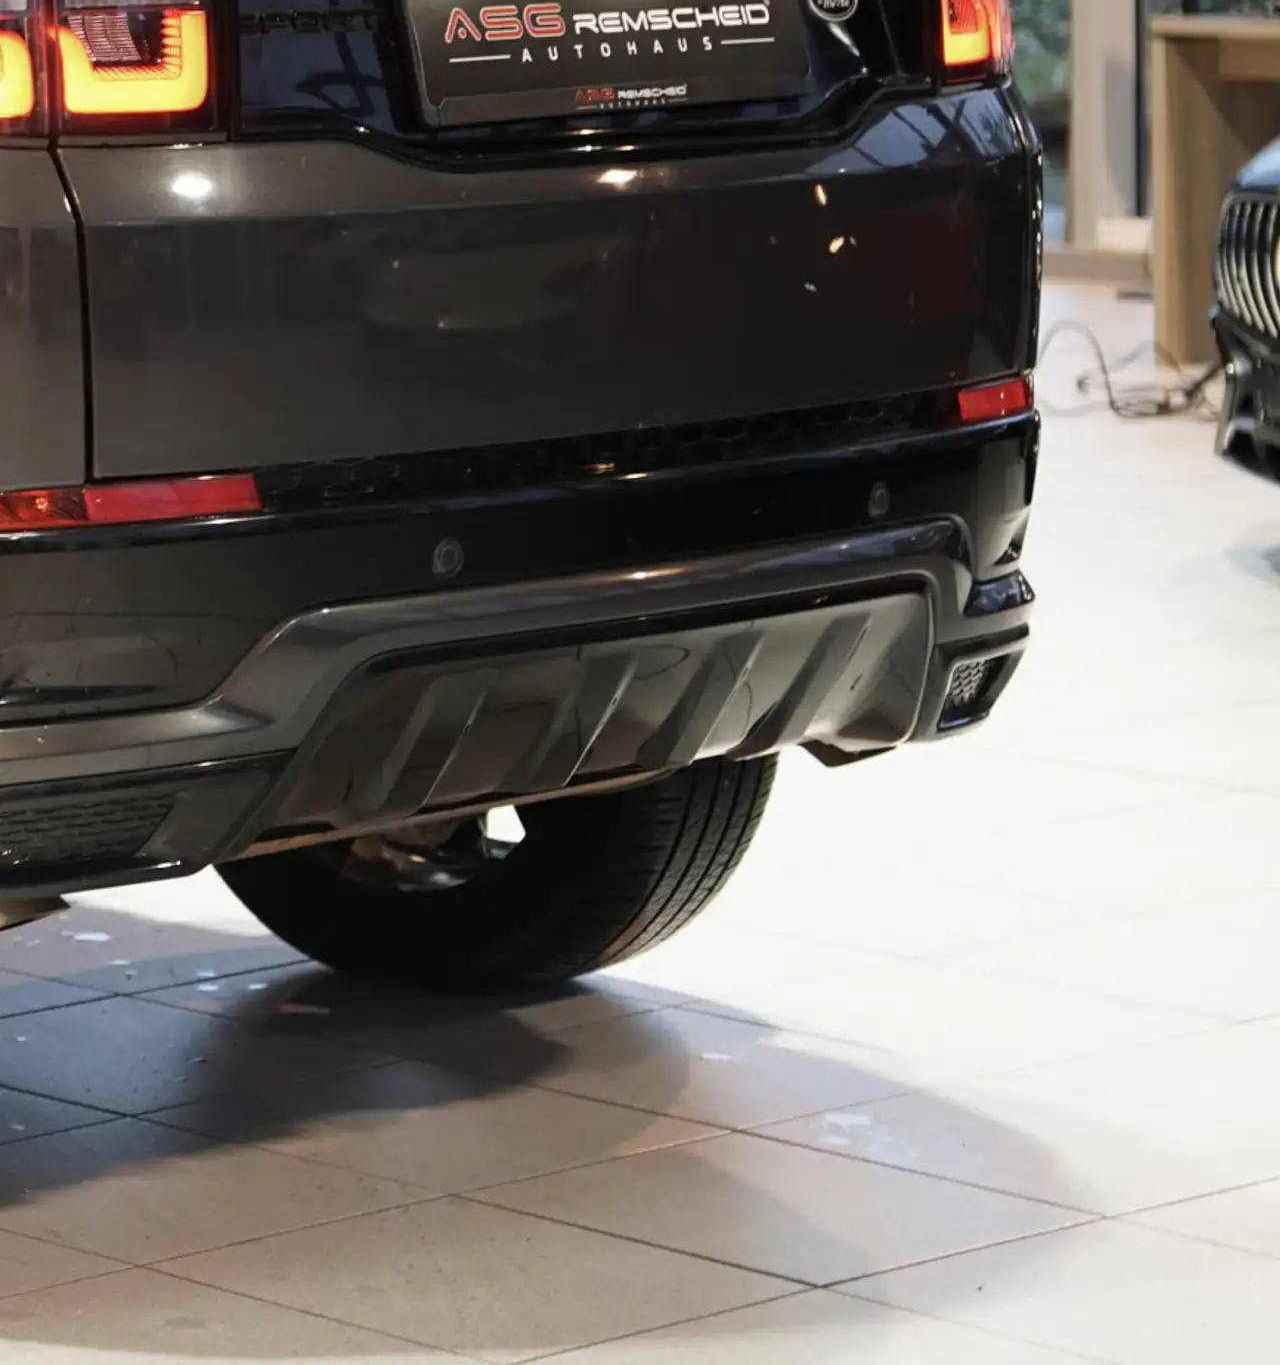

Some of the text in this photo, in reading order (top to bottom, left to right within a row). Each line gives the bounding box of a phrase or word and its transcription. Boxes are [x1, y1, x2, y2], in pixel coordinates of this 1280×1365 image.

[444, 2, 770, 44] ASG REMSCHEID
[521, 36, 713, 64] AUTOHAUS
